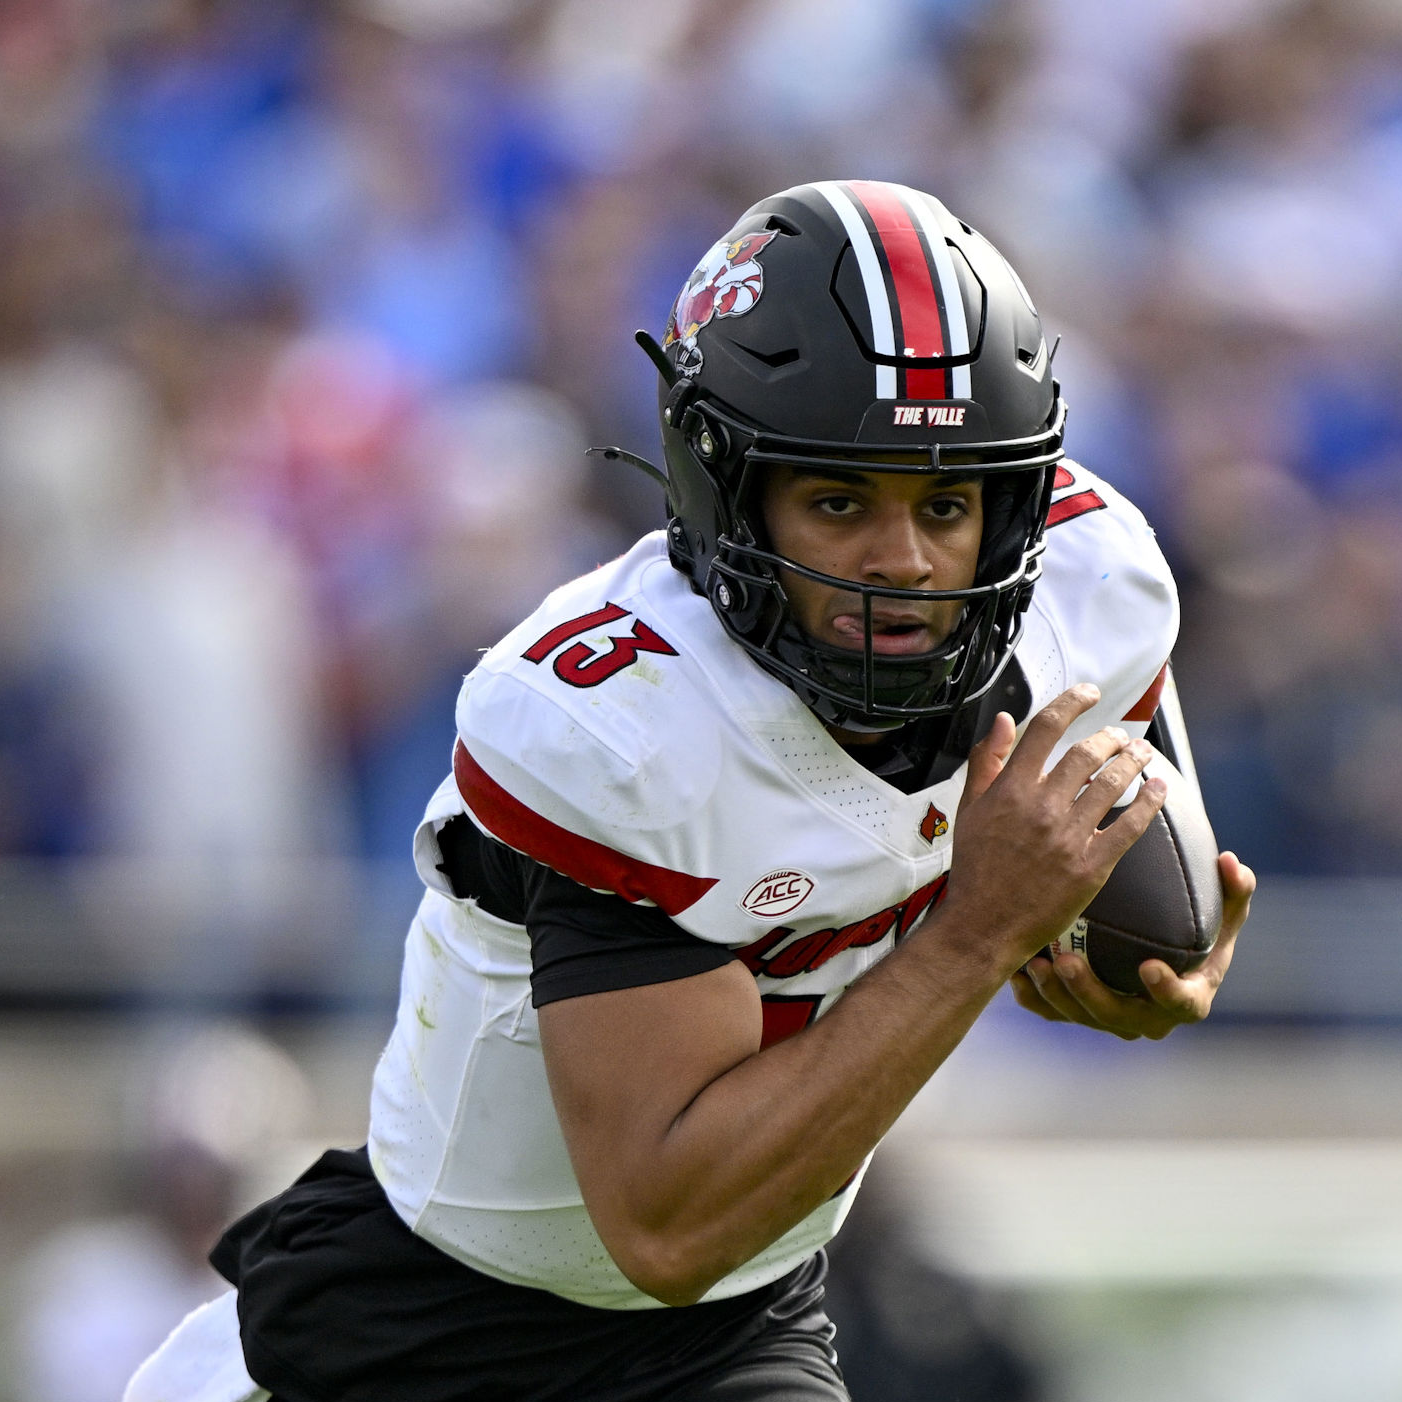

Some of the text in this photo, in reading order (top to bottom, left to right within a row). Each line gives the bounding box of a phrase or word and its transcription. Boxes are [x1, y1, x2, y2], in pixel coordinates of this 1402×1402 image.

[893, 406, 966, 428] THE VILLE
[520, 601, 681, 688] 13
[752, 877, 804, 904] ACC
